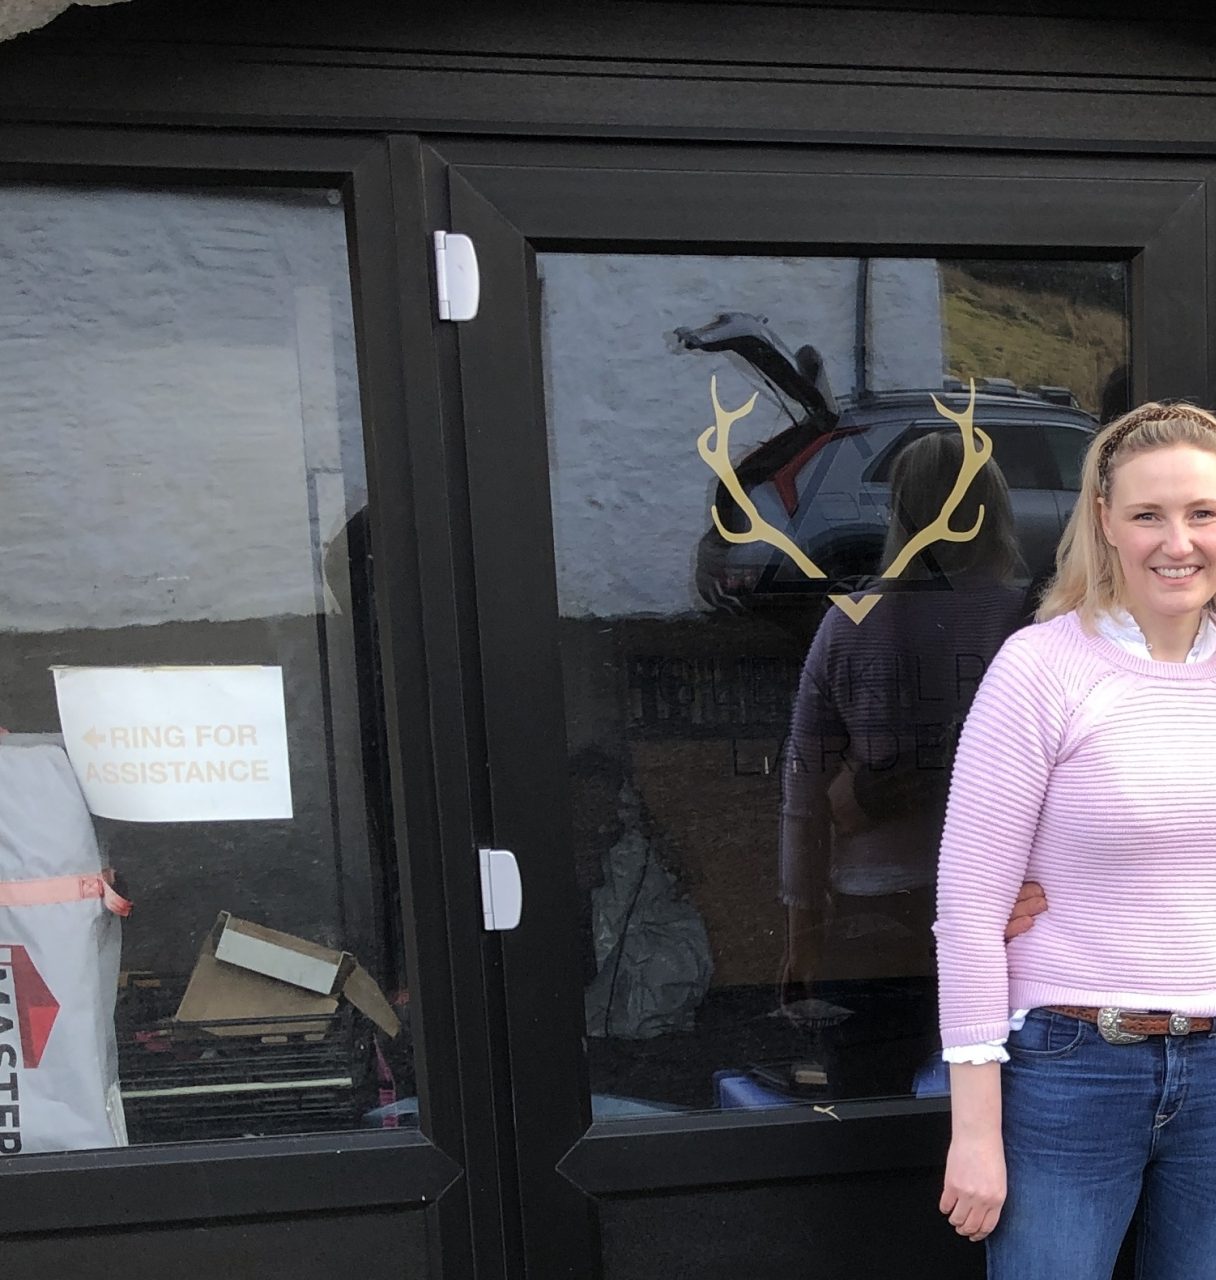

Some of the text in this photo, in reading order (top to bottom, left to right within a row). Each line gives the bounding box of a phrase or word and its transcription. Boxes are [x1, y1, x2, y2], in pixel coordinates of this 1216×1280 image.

[658, 653, 988, 706] GLENKILR
[110, 724, 258, 748] RING FOR
[732, 721, 966, 777] LARDE
[86, 759, 269, 784] ASSISTANCE
[0, 968, 22, 1154] STER
